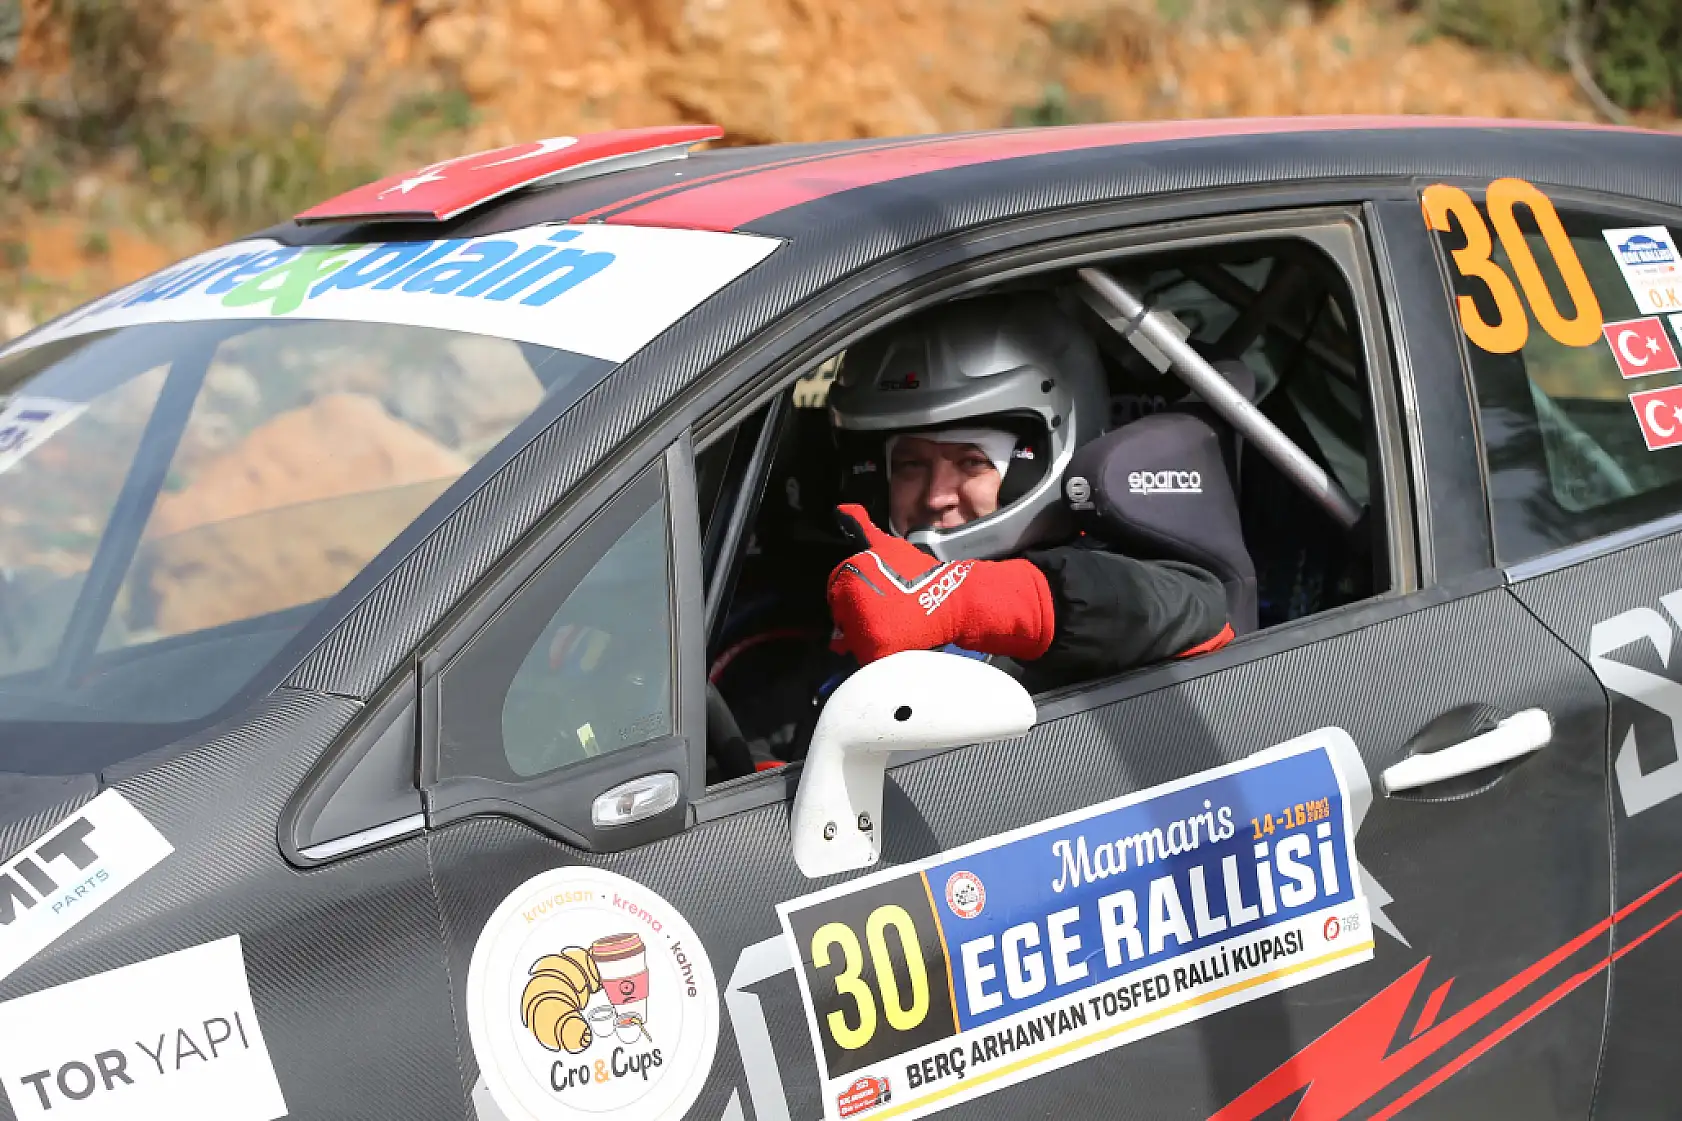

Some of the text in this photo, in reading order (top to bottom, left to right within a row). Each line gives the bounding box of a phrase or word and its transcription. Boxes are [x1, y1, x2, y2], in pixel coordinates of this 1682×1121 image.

[1421, 177, 1603, 354] 30
[1127, 470, 1203, 496] sparco
[1052, 799, 1235, 892] Marmaris
[1251, 803, 1307, 841] 14-16
[51, 868, 110, 914] PARTS
[522, 889, 698, 999] kruvasan krema kahve
[811, 903, 931, 1051] 30
[959, 905, 1089, 1017] EGE
[906, 929, 1305, 1089] BERÇ ARHANYAN TOSFED RALLİ KUPASI
[20, 1011, 249, 1111] TOR YAPI
[550, 1046, 663, 1092] Cro & Cups
